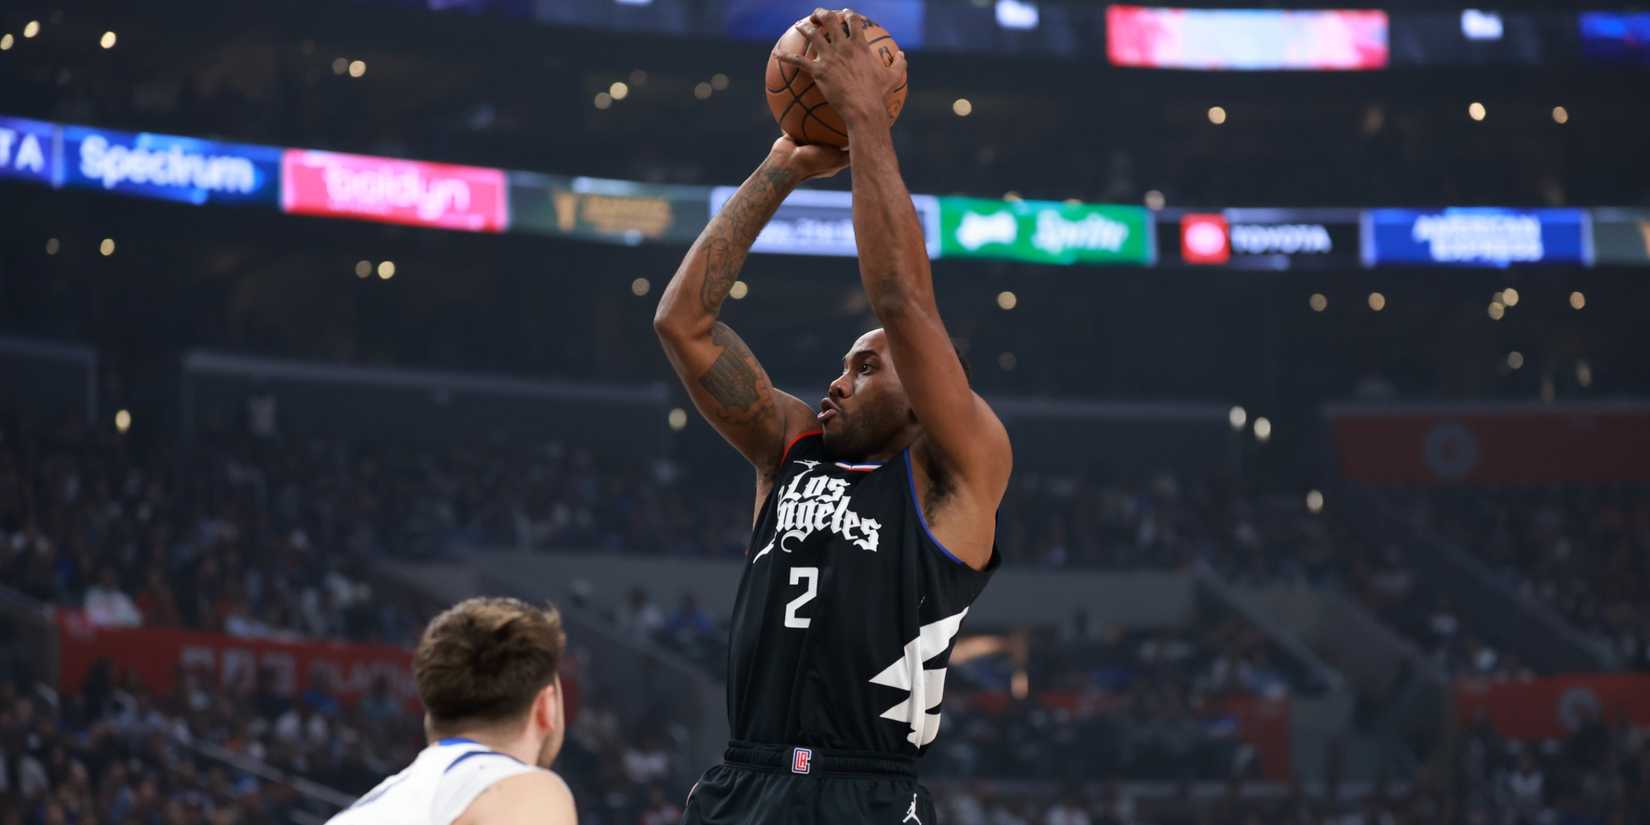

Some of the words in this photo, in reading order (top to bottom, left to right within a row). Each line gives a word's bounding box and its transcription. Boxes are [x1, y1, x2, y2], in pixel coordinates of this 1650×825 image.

[1230, 223, 1332, 254] TOYOTA
[780, 467, 852, 502] Los
[784, 566, 819, 629] 2
